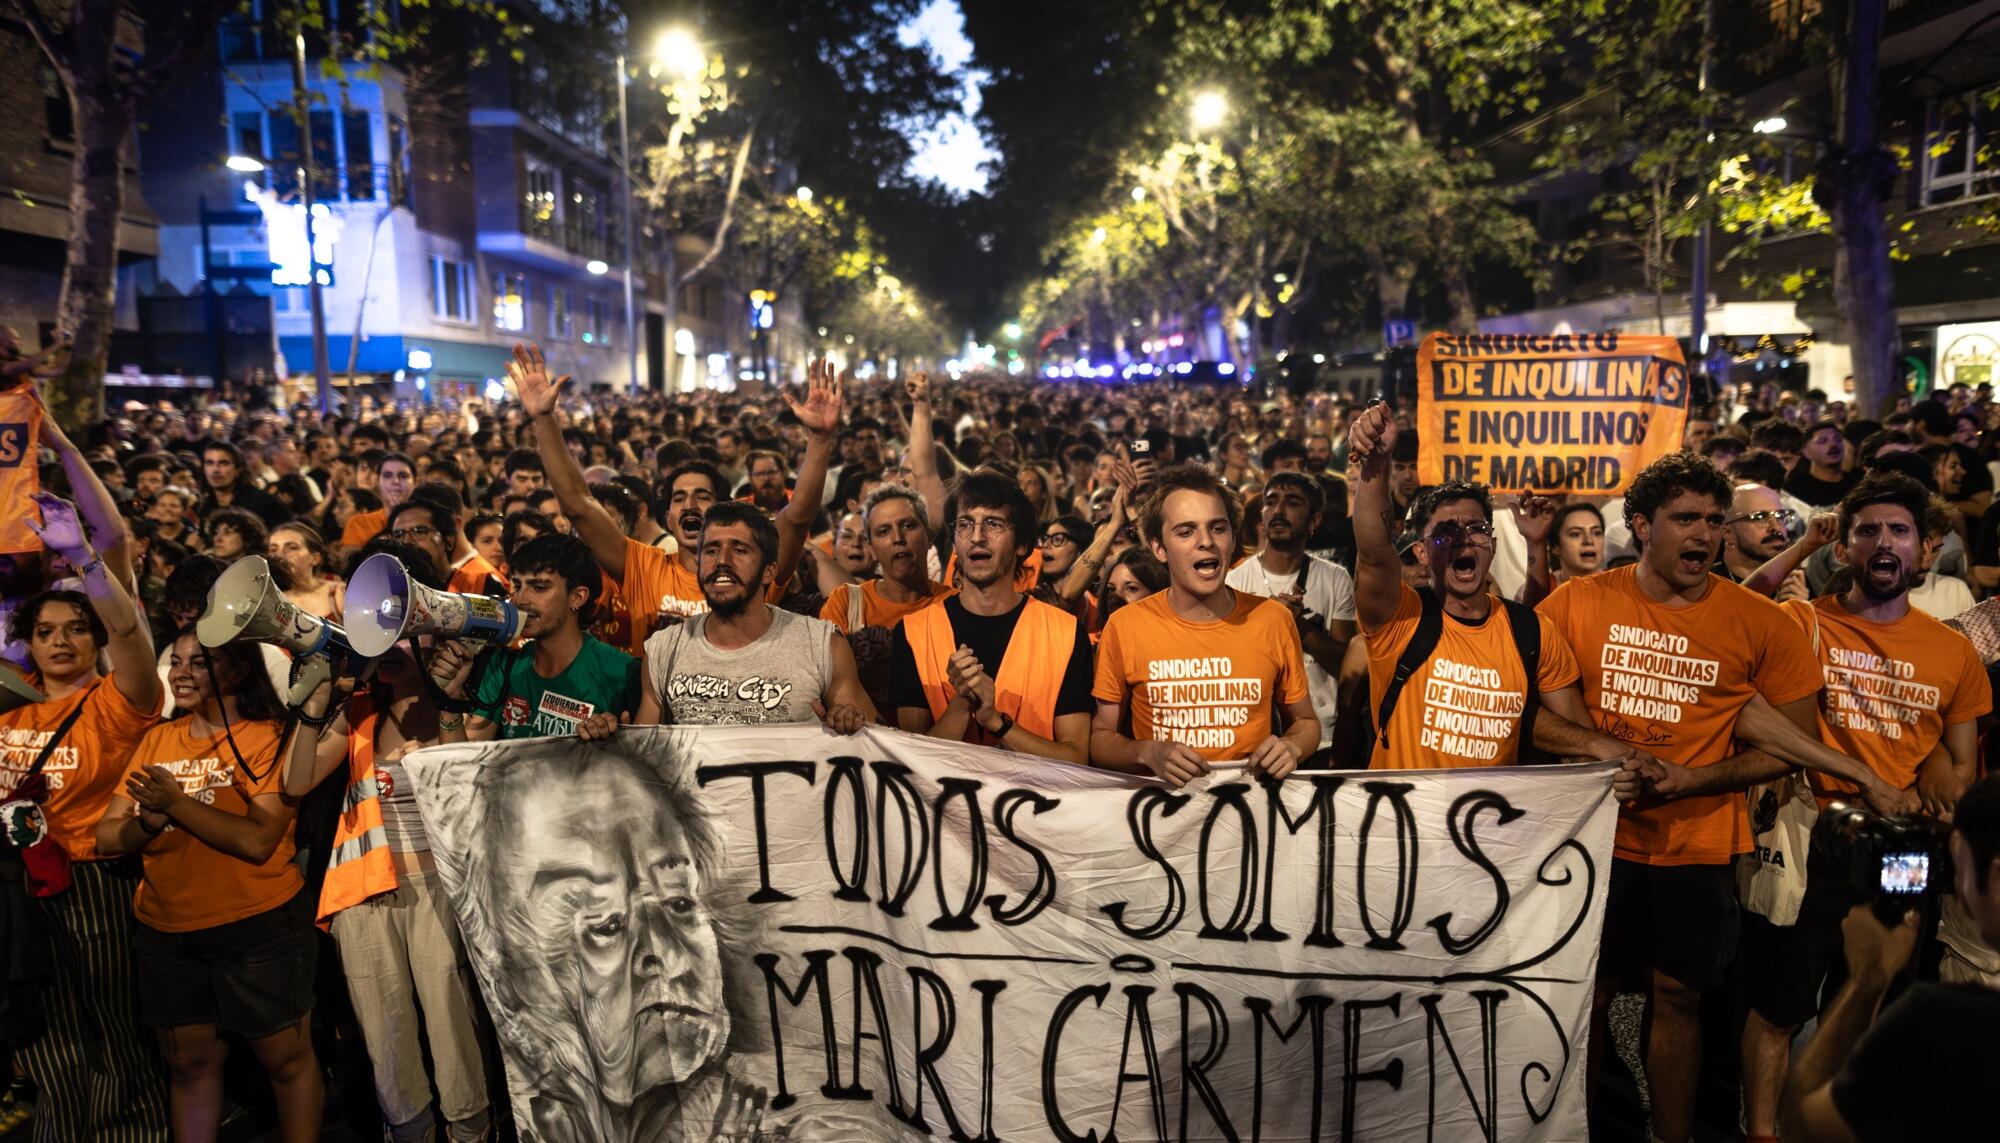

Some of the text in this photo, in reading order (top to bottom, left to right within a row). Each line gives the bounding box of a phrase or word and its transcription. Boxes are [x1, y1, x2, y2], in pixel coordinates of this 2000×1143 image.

[1443, 361, 1683, 401] DE INQUILINAS
[1443, 410, 1648, 448] E INQUILINOS
[1443, 455, 1621, 490] DE MADRID
[1609, 623, 1688, 655] SINDICATO
[1149, 657, 1232, 680] SINDICATO
[1433, 657, 1501, 689] SINDICATO
[1604, 647, 1715, 682] DE INQUILINAS
[1829, 647, 1915, 679] SINDICATO
[1150, 682, 1259, 704] DE INQUILINAS
[1428, 682, 1522, 714] DE INQUILINAS
[1602, 670, 1699, 704] E INQUILINOS
[1827, 670, 1936, 706] DE INQUILINAS
[1152, 707, 1248, 729] E INQUILINOS
[1424, 706, 1512, 739] E INQUILINOS
[1600, 690, 1681, 723] DE MADRID
[1826, 691, 1921, 725] E INQUILINOS
[1152, 725, 1236, 748] DE MADRID
[1600, 713, 1634, 739] Nodo
[1825, 709, 1902, 740] DE MADRID
[1421, 727, 1498, 760] DE MADRID
[695, 755, 1526, 956] TODOS SOMOS
[753, 946, 1008, 1143] MARI
